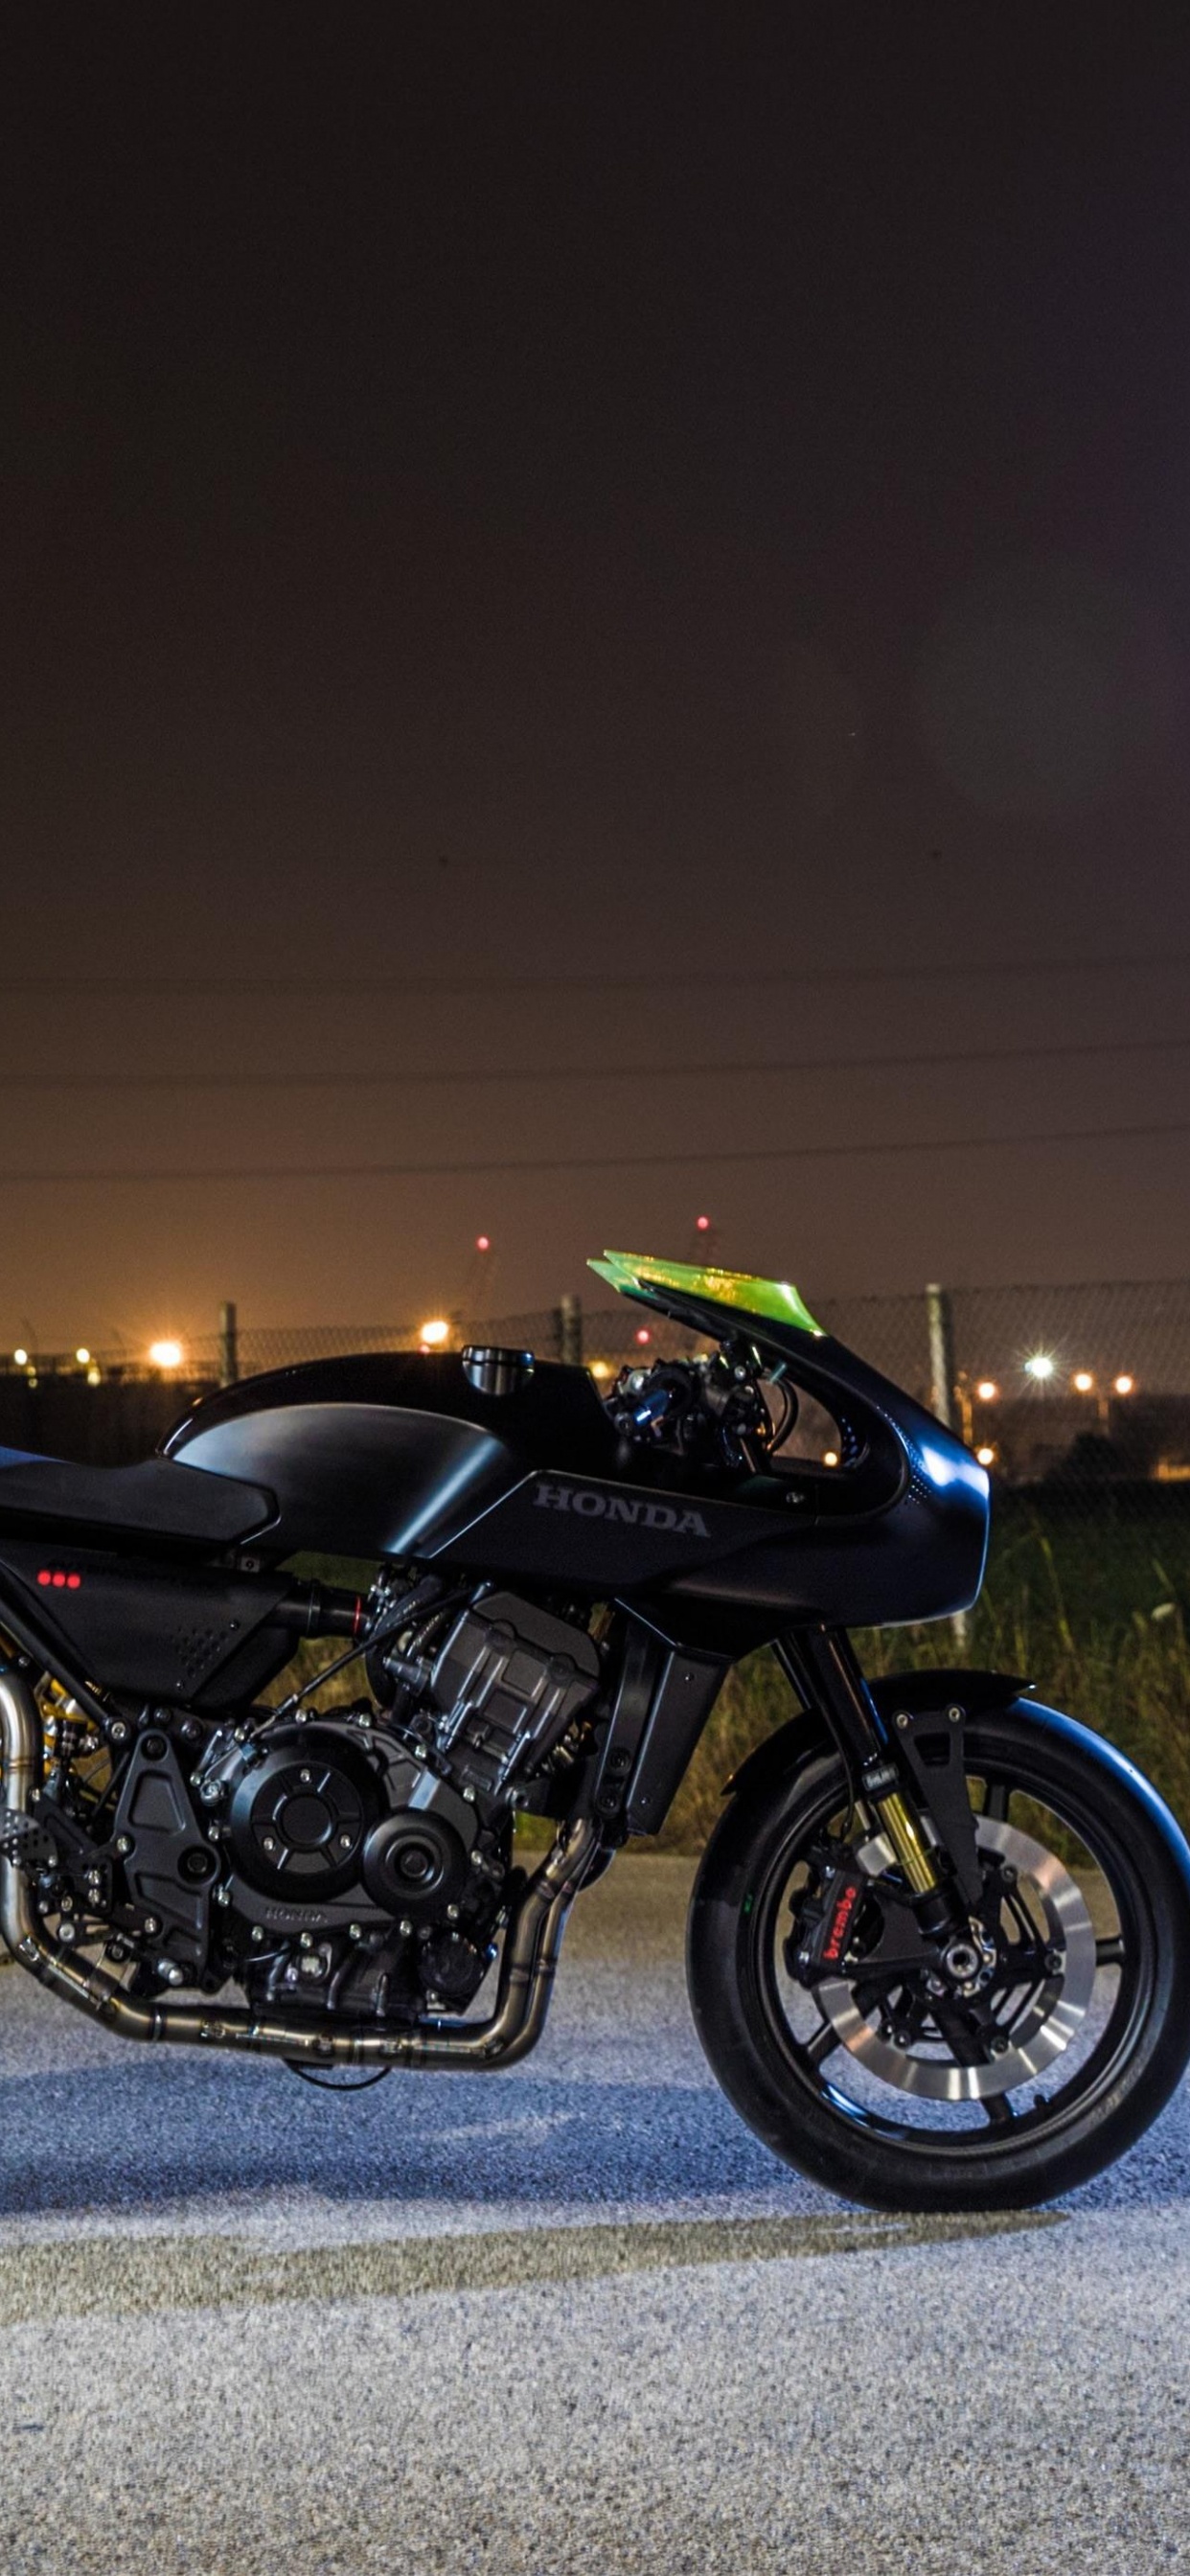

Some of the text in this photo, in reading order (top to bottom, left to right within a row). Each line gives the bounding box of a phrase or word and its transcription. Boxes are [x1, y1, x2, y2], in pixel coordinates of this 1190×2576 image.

[533, 1484, 711, 1538] HONDA
[265, 1906, 329, 1923] HONDA
[823, 1886, 857, 1960] brembo
